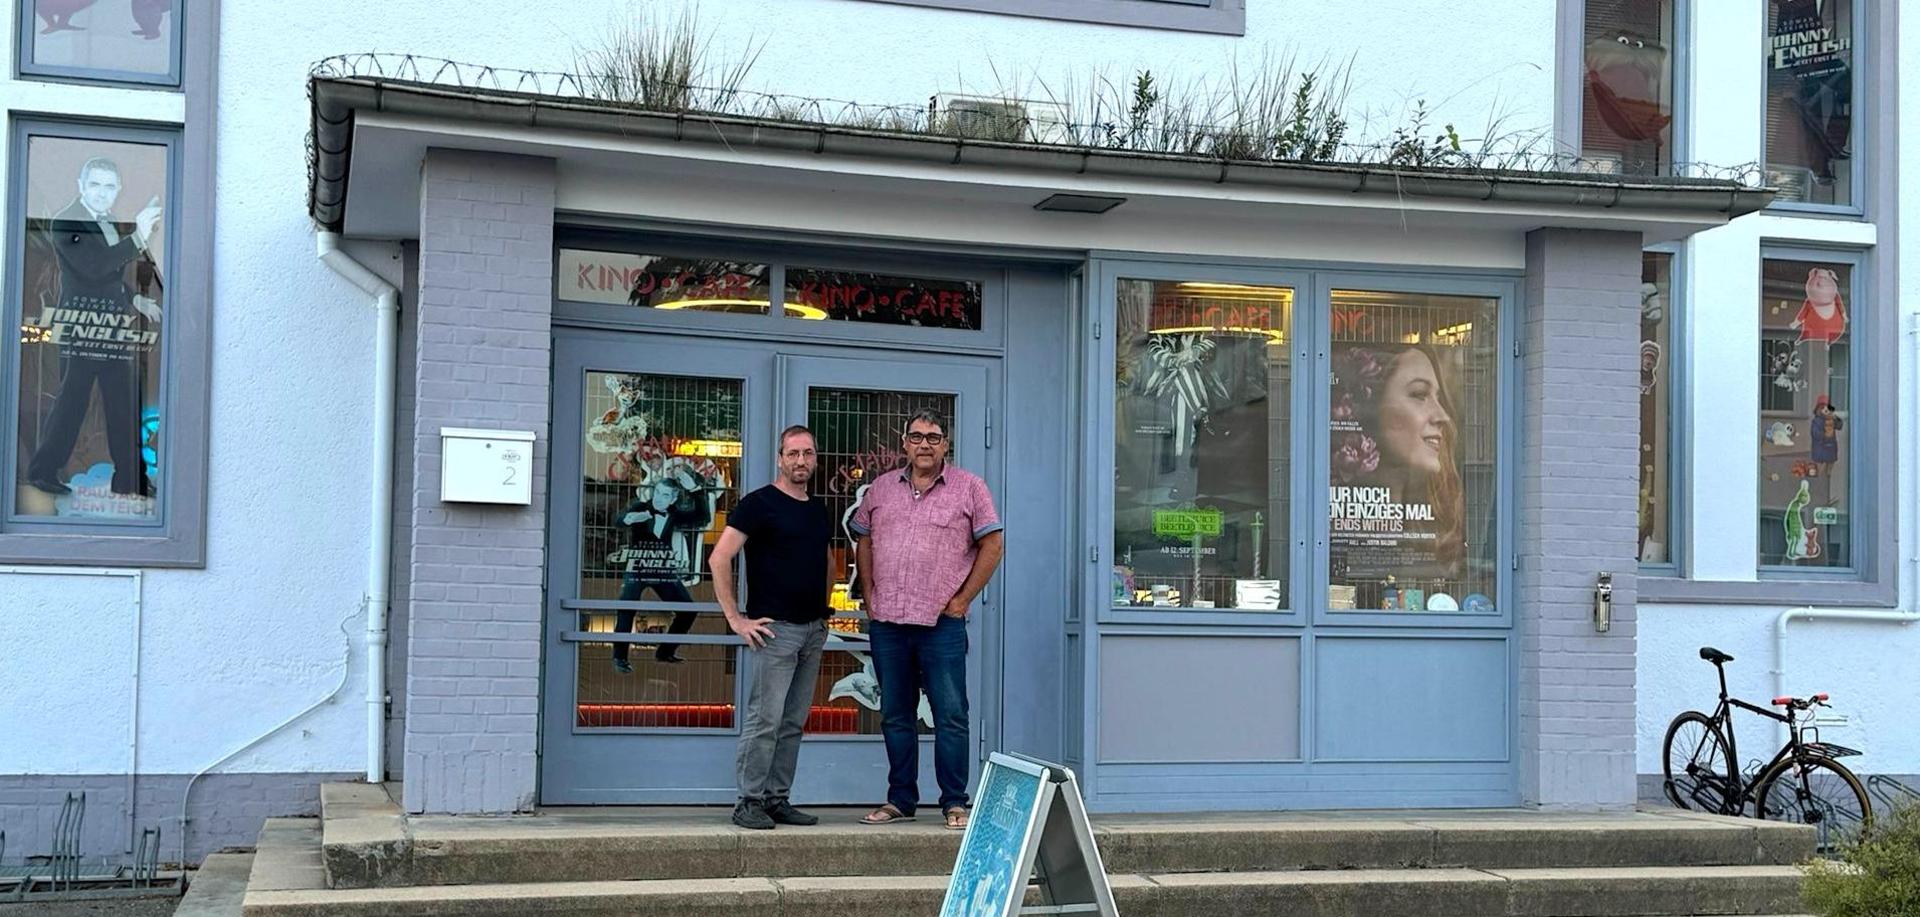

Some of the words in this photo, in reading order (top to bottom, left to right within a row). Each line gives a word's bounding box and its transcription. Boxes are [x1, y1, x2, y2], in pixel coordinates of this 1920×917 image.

[1767, 27, 1832, 57] JOHNNY
[1775, 38, 1851, 69] ENGLISH
[578, 263, 656, 295] KINO
[799, 283, 875, 312] KINO
[896, 290, 965, 319] CAFE
[28, 307, 137, 328] JOHNNY
[49, 323, 159, 345] ENGLISH
[503, 466, 517, 485] 2
[1353, 487, 1391, 504] NOCH
[1346, 502, 1404, 520] EINZIGES
[1406, 504, 1435, 520] MAL
[1335, 519, 1361, 531] ENDS
[1362, 519, 1389, 531] WITH
[1390, 520, 1404, 532] US
[607, 545, 679, 563] JOHNNY
